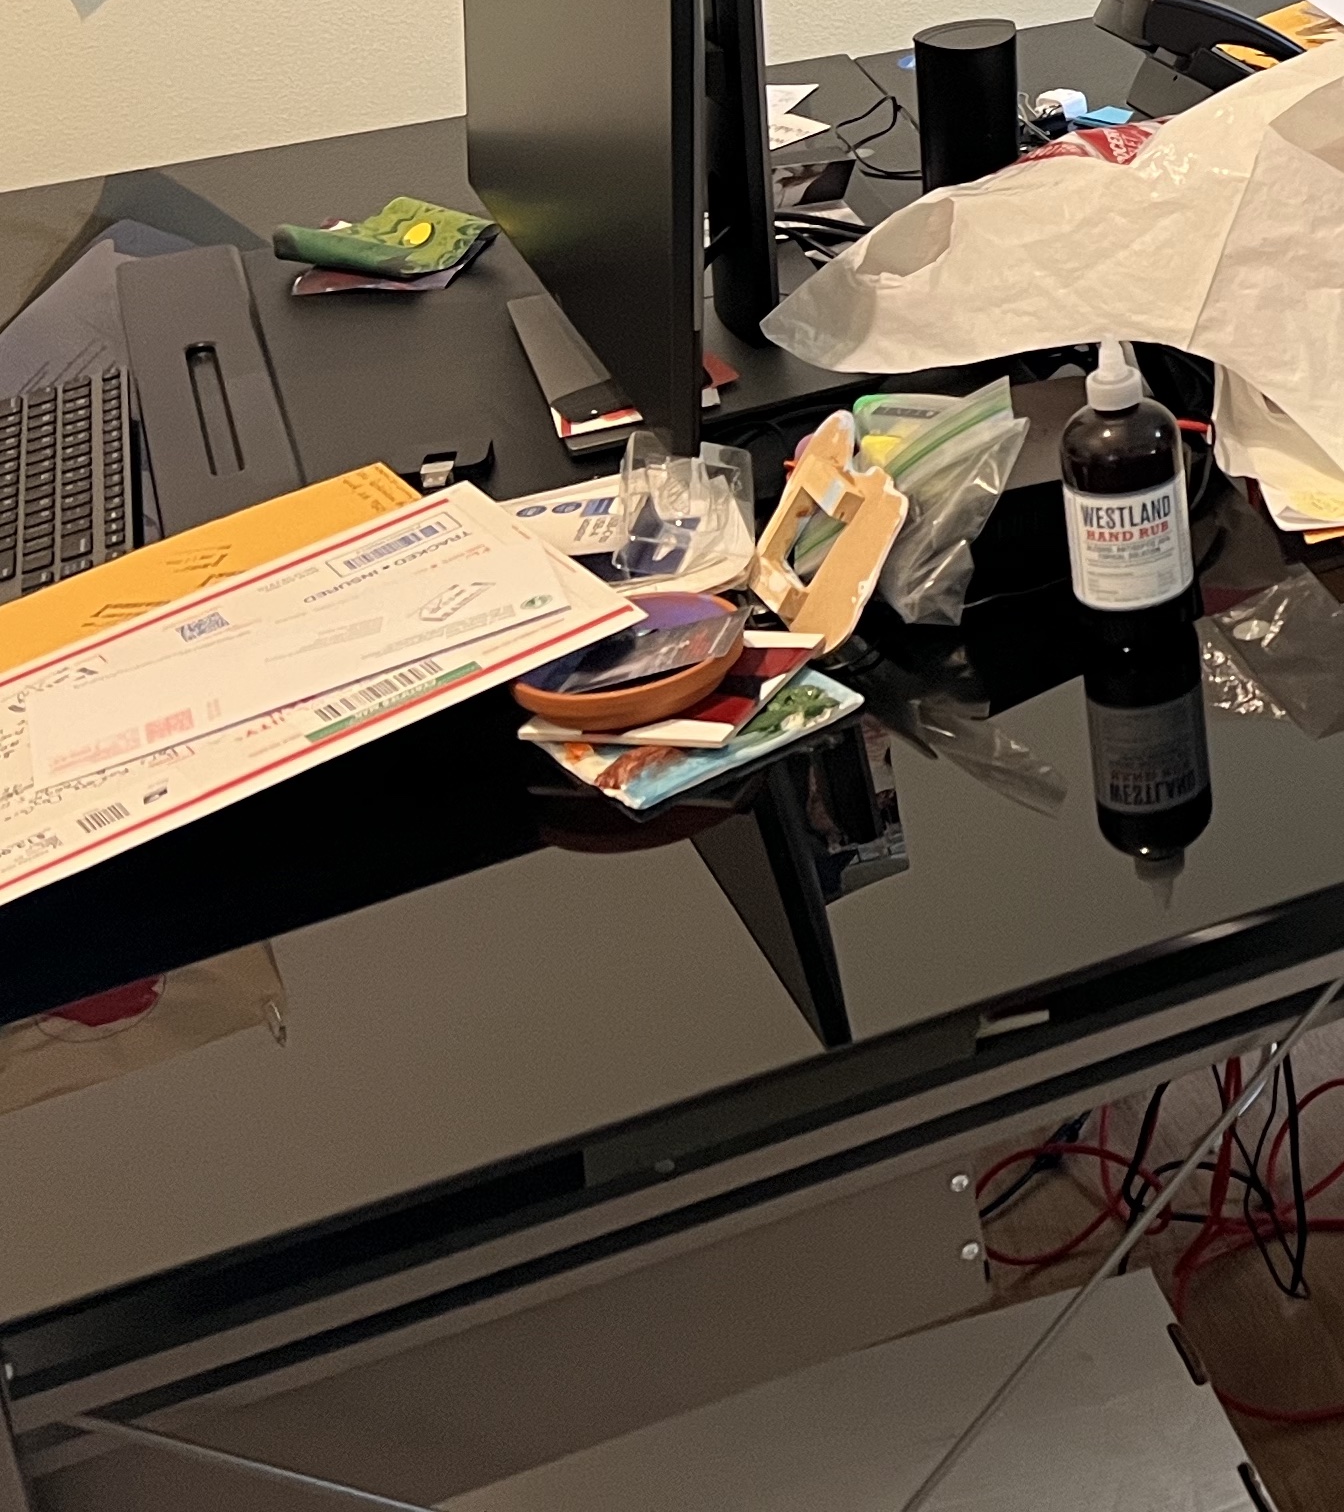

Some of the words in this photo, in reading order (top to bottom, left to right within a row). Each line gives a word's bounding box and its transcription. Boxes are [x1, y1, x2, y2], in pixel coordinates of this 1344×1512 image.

[1080, 494, 1172, 531] WESTLAND
[392, 530, 473, 567] TRACKED
[1086, 528, 1135, 543] HAND
[1138, 520, 1170, 539] RUB
[302, 568, 379, 605] INSURED
